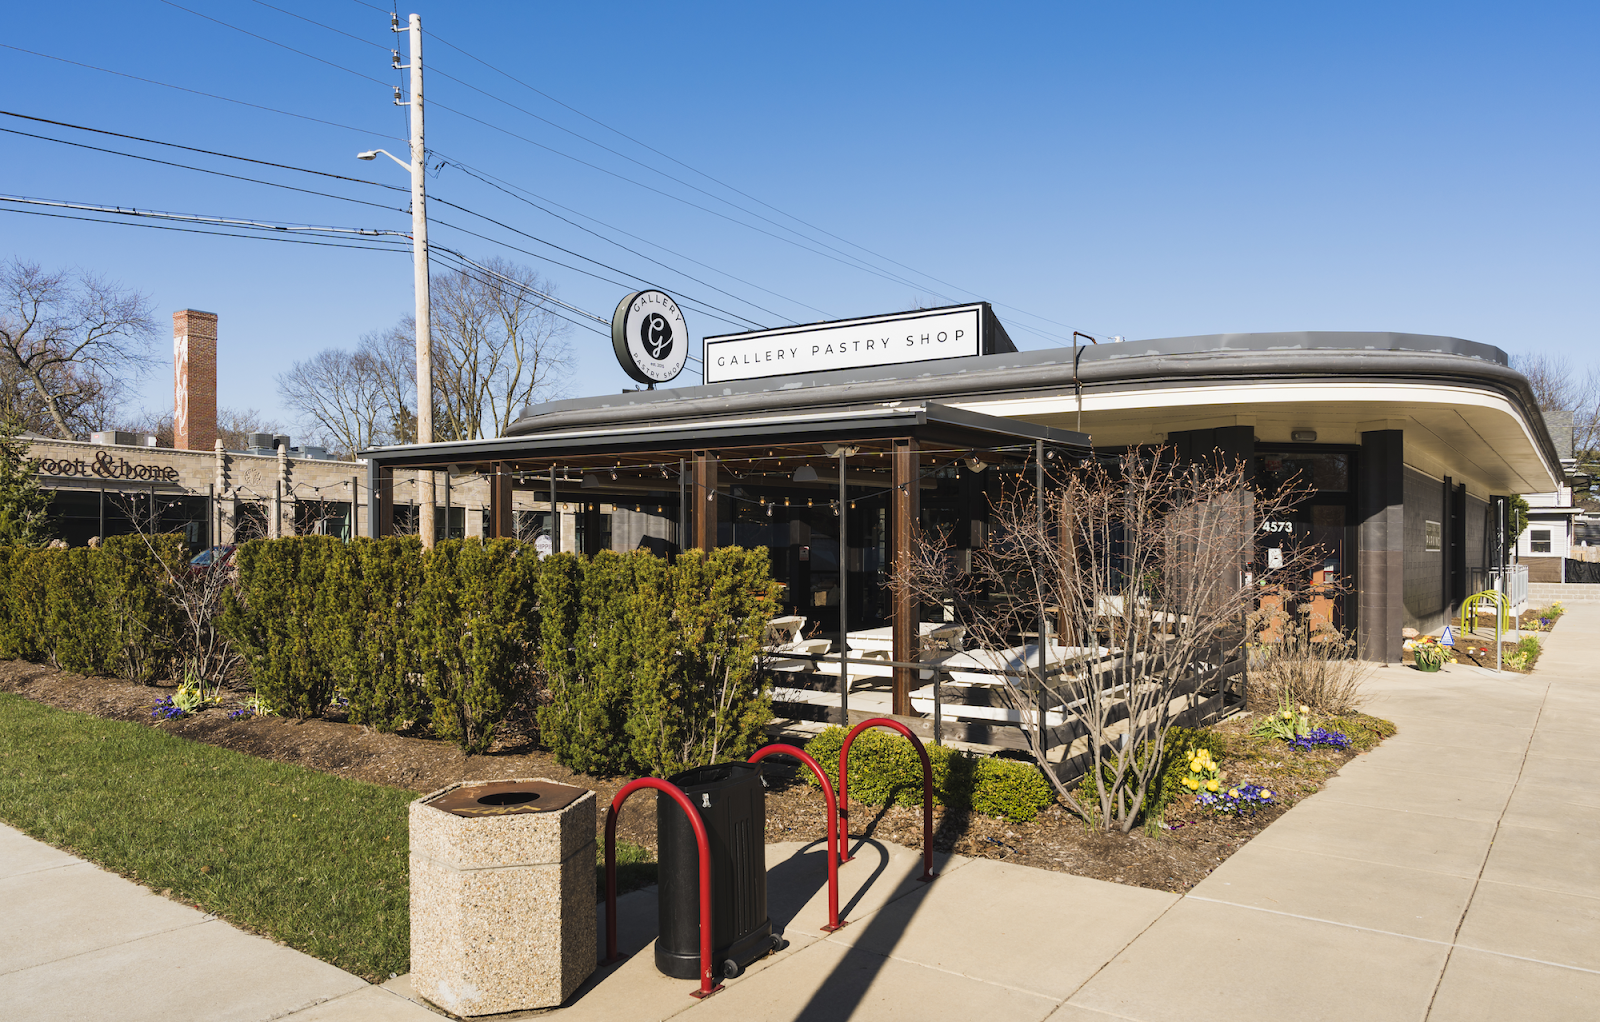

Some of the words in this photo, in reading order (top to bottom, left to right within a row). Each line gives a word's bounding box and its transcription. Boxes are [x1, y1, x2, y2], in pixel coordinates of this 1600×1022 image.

[633, 294, 682, 322] GALLERY
[717, 347, 798, 367] GALLERY
[811, 337, 890, 356] PASTRY
[905, 329, 965, 347] SHOP
[633, 352, 660, 379] PASTRY
[663, 362, 680, 379] SHOP
[1262, 521, 1293, 533] 4573
